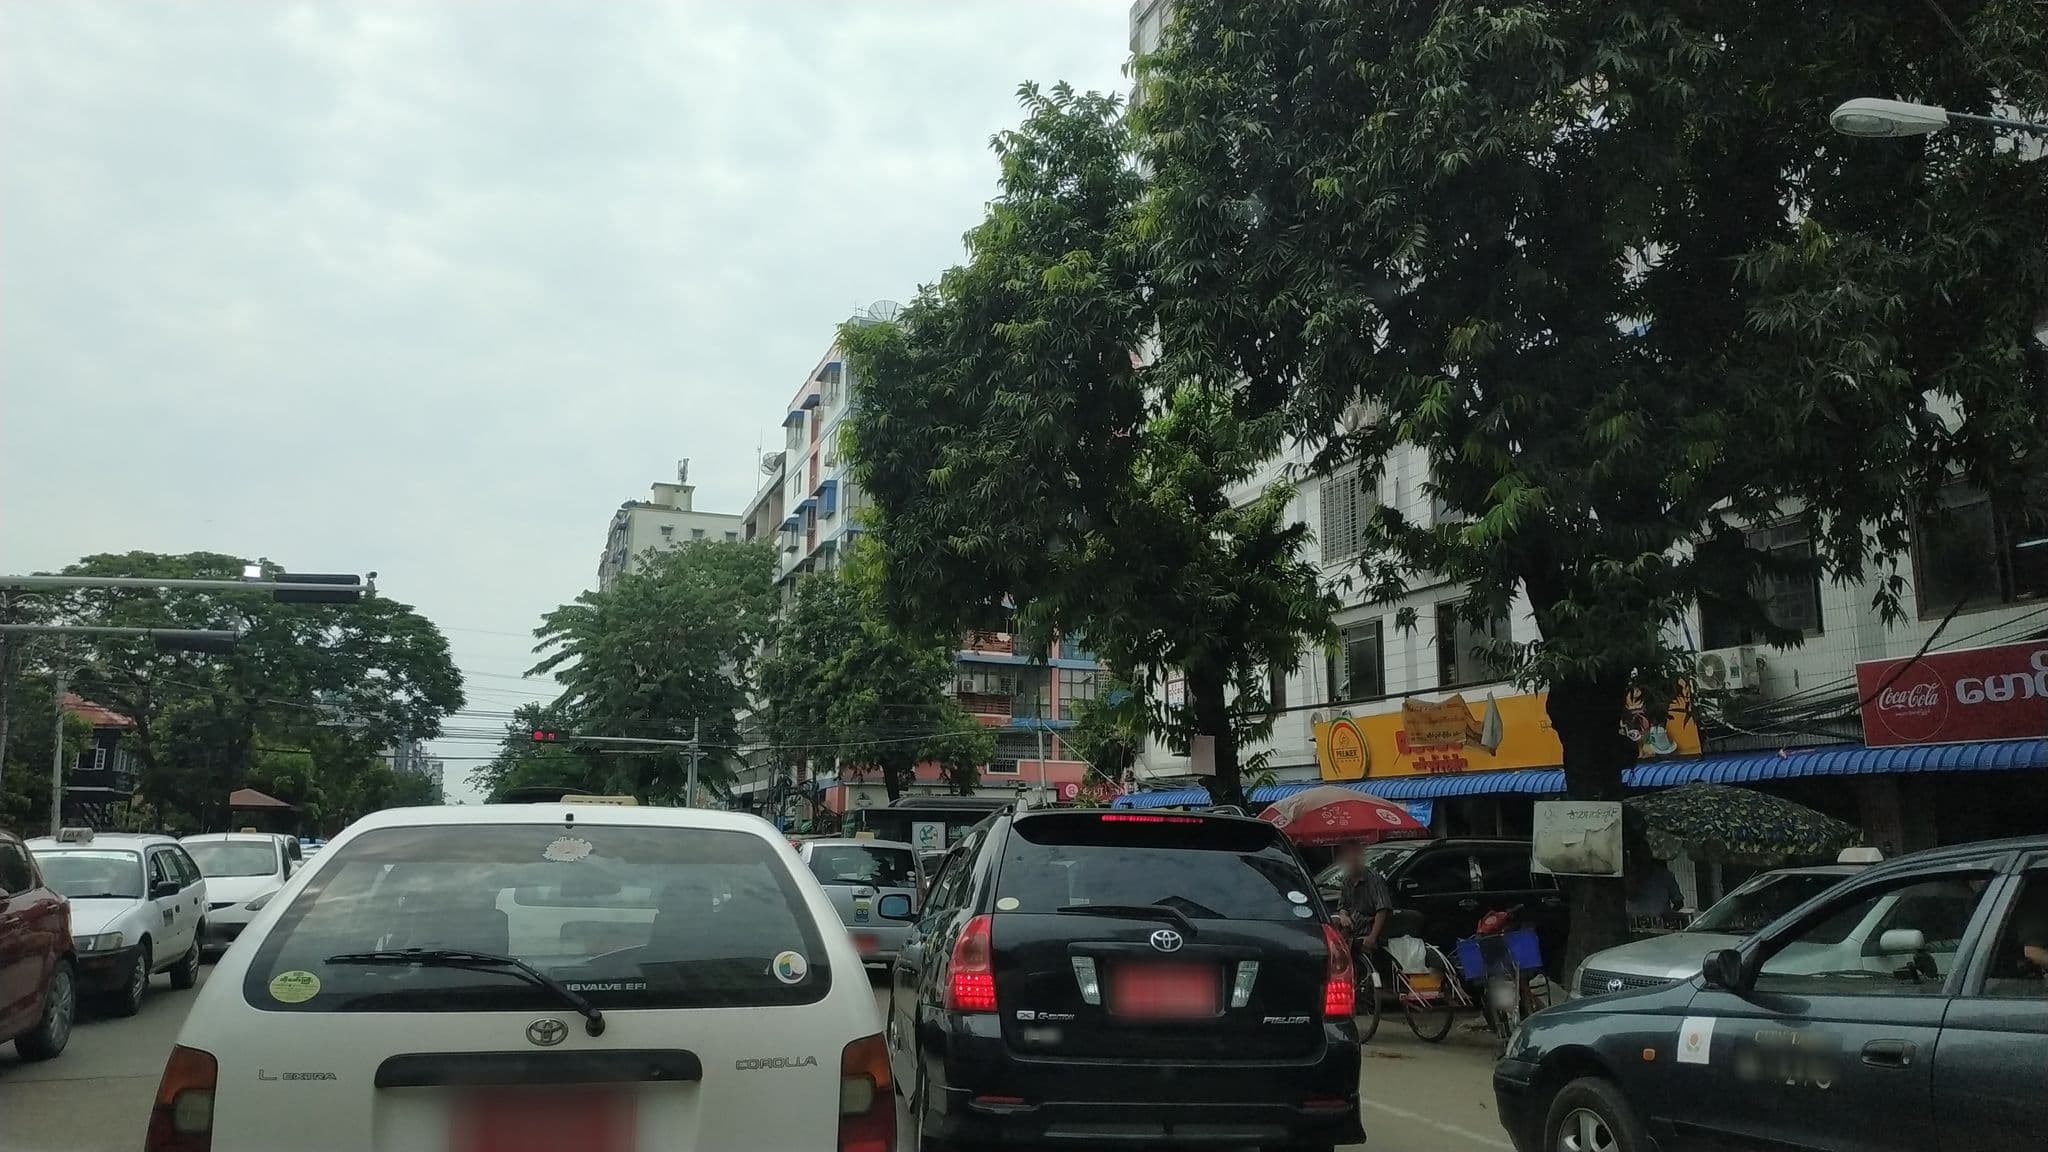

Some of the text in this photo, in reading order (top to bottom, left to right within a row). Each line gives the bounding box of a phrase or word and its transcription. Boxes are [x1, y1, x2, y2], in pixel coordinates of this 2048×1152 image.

[1879, 681, 1941, 710] Coca-Cola
[625, 982, 647, 990] EFI
[736, 1055, 818, 1071] COROLLA
[258, 1068, 337, 1080] L EXTRA
